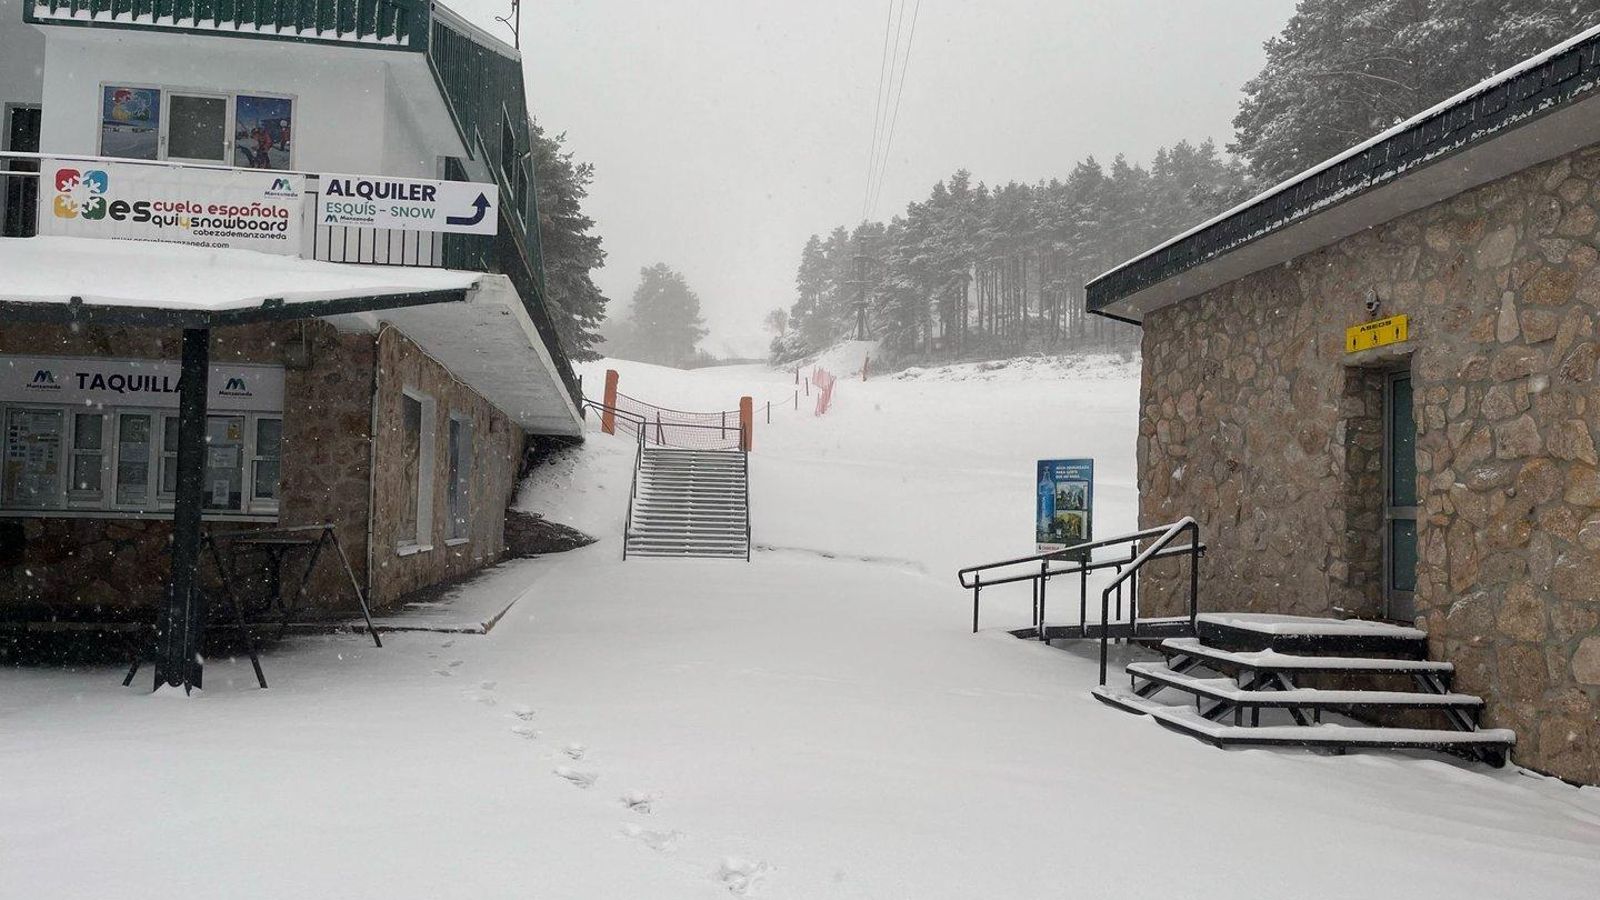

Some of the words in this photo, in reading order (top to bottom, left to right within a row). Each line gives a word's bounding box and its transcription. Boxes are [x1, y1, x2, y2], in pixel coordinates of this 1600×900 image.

[326, 179, 436, 202] ALQUILER
[208, 203, 289, 219] española
[326, 201, 376, 216] ESQUÍS
[391, 206, 435, 219] SNOW
[193, 230, 287, 240] cabezademanzaneda
[1360, 320, 1391, 332] ASEOS
